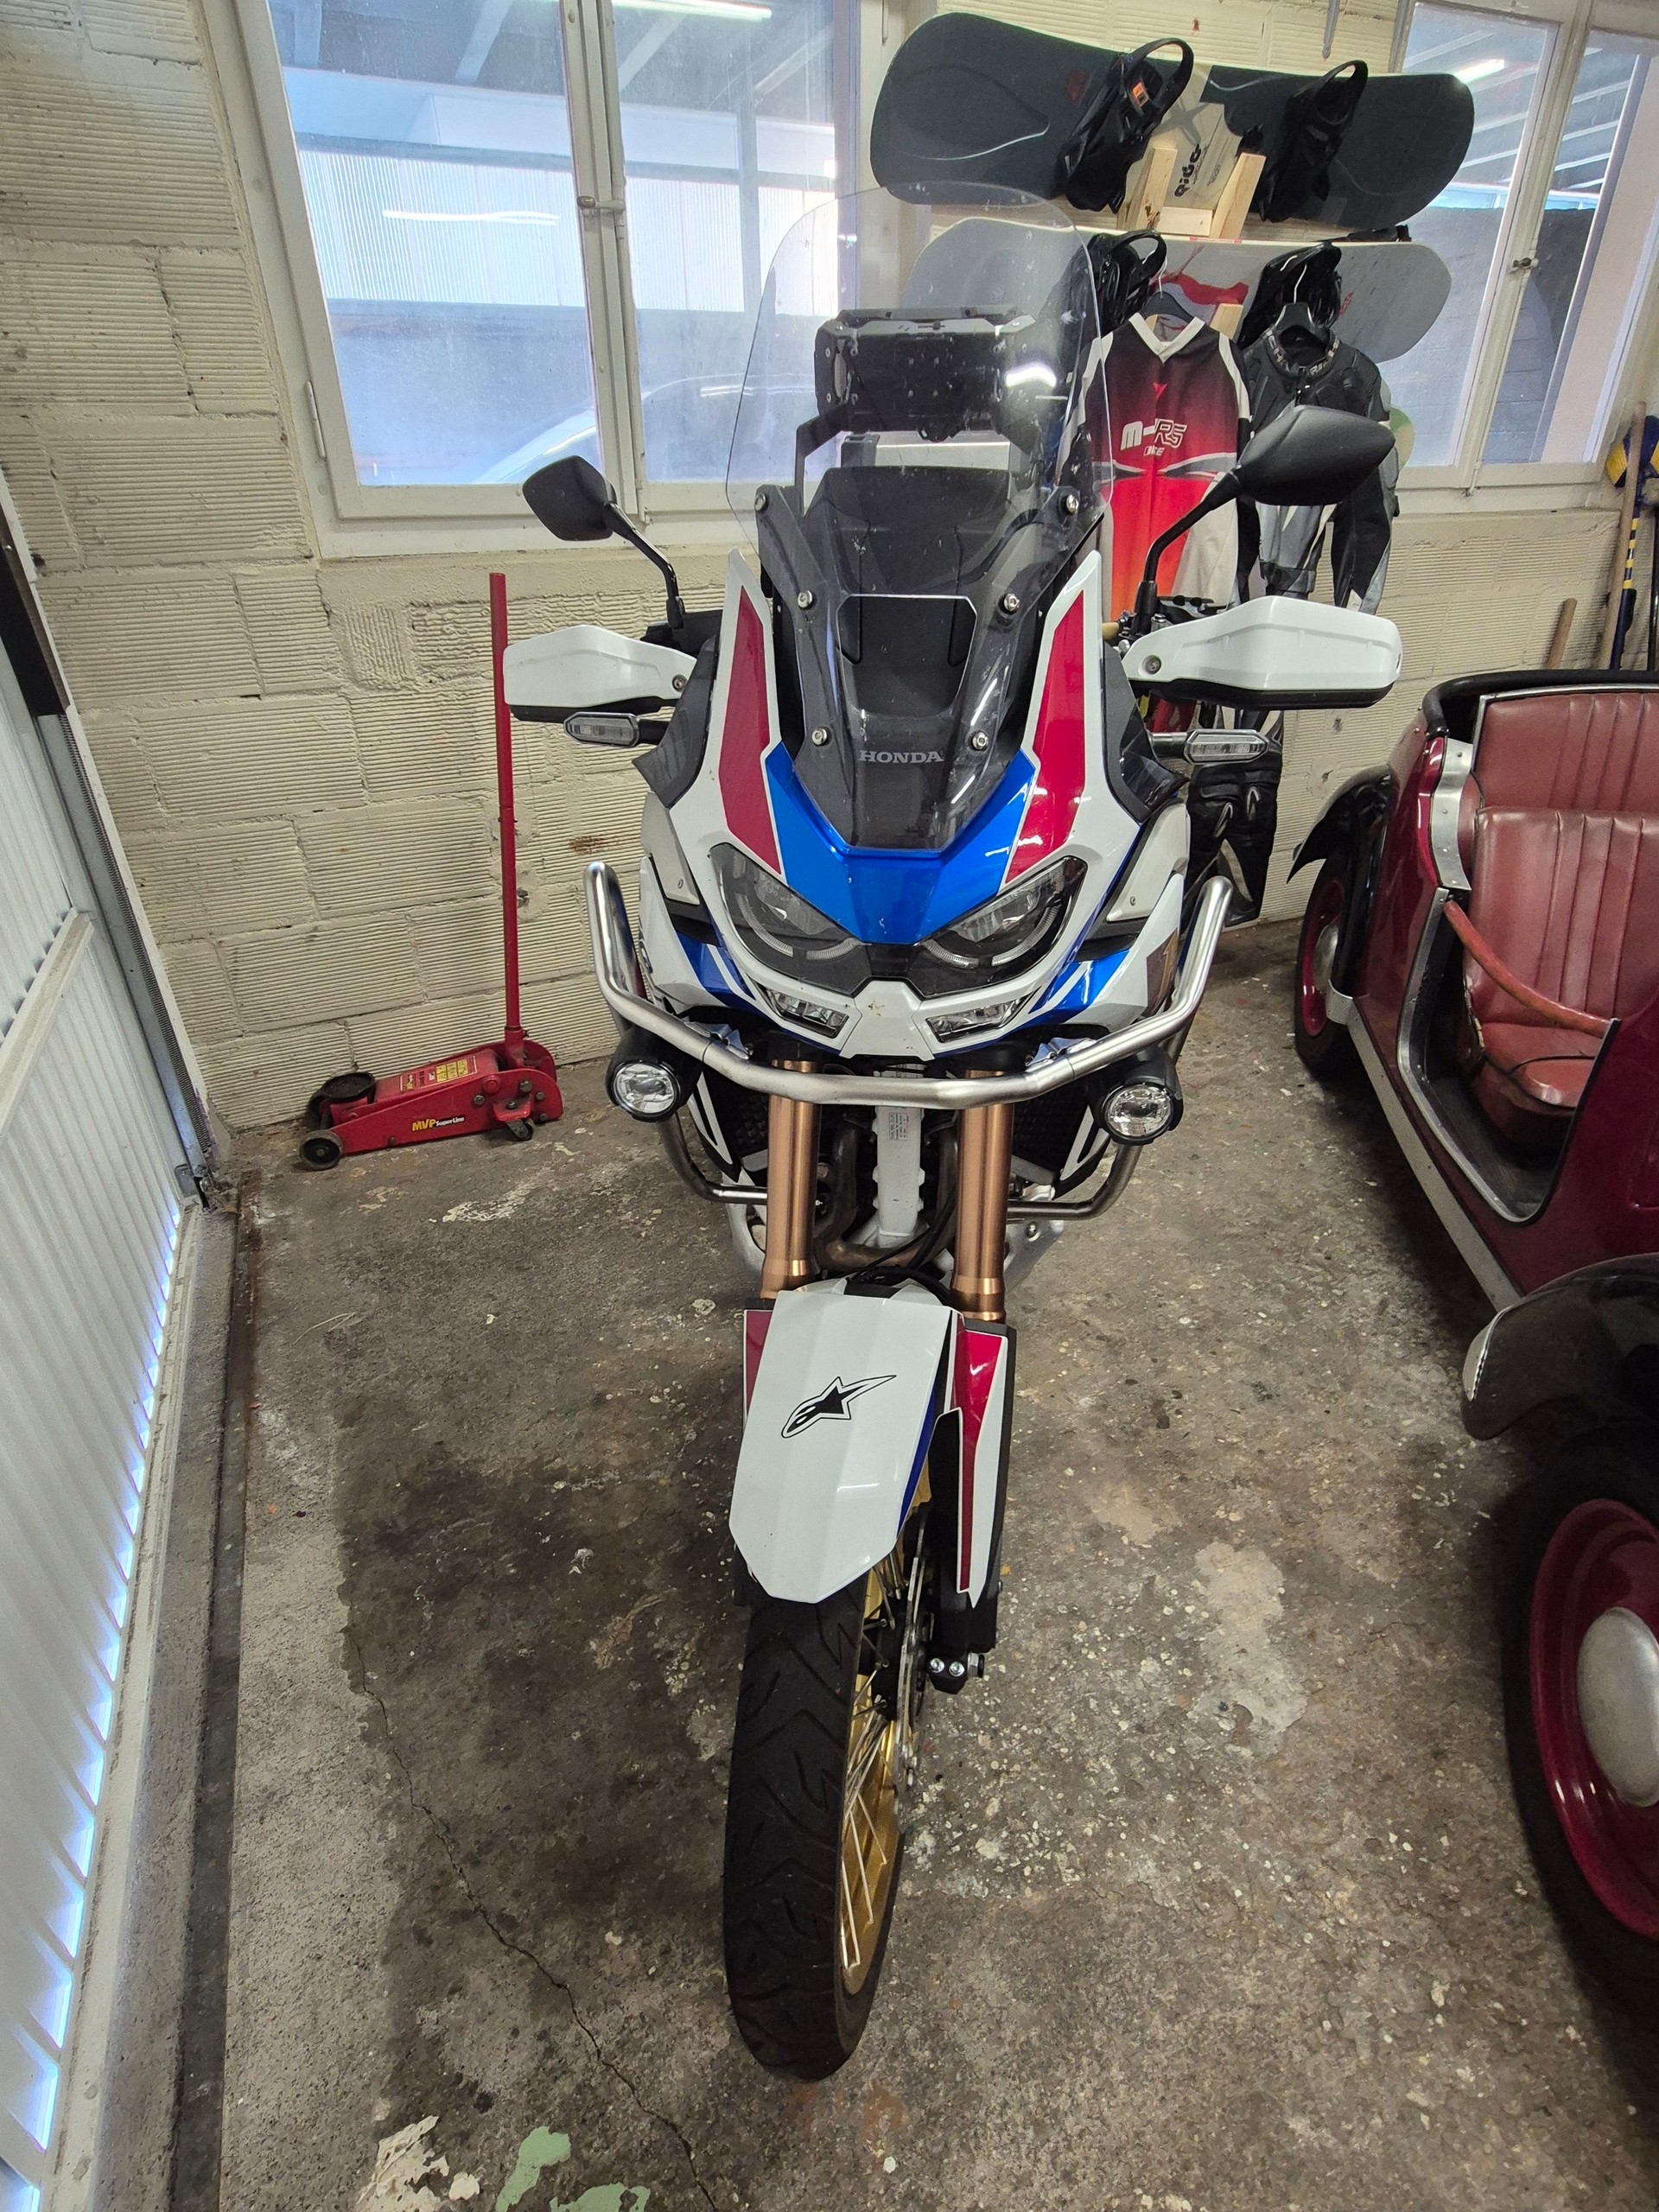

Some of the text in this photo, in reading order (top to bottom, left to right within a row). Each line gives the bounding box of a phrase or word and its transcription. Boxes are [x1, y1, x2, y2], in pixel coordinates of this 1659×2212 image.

[1120, 418, 1188, 451] M-RS
[858, 750, 944, 764] HONDA
[411, 1118, 436, 1132] MVP
